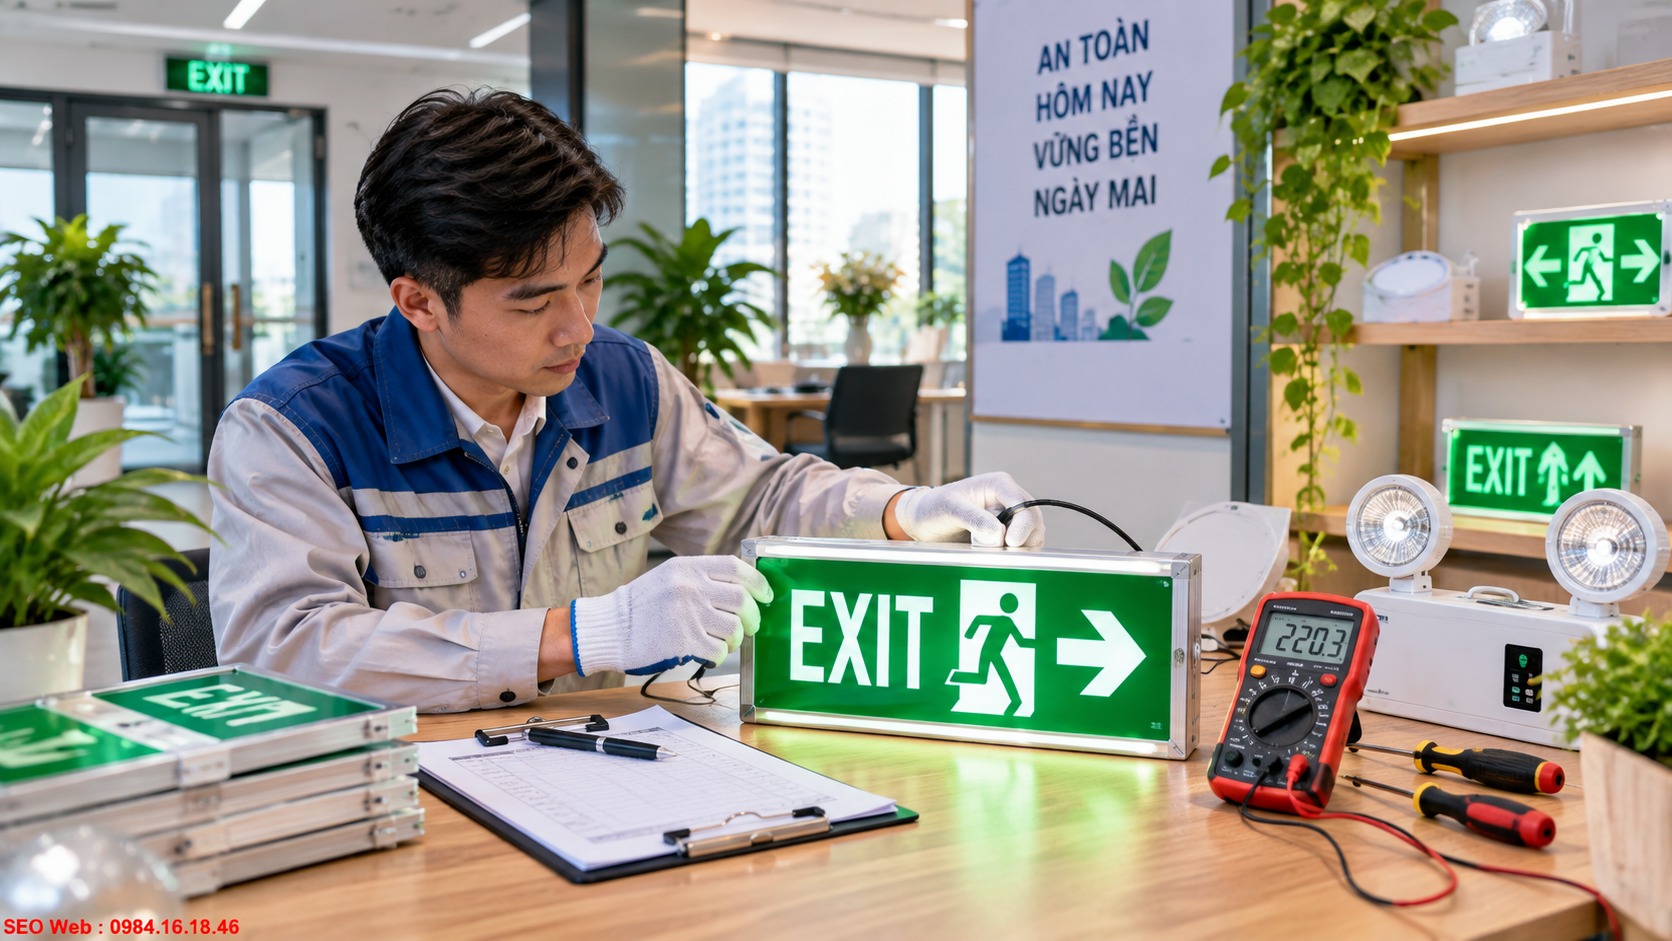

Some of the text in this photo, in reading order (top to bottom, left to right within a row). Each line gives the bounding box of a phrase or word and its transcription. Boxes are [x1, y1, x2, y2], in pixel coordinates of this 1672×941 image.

[1038, 17, 1149, 74] AN TOÀN
[188, 60, 250, 95] EXIT
[1037, 70, 1153, 122] HÔM NAY
[1035, 175, 1156, 217] NGÀY MAI
[1465, 444, 1533, 497] EXIT
[790, 589, 934, 690] EXIT
[1276, 623, 1347, 658] 220.3
